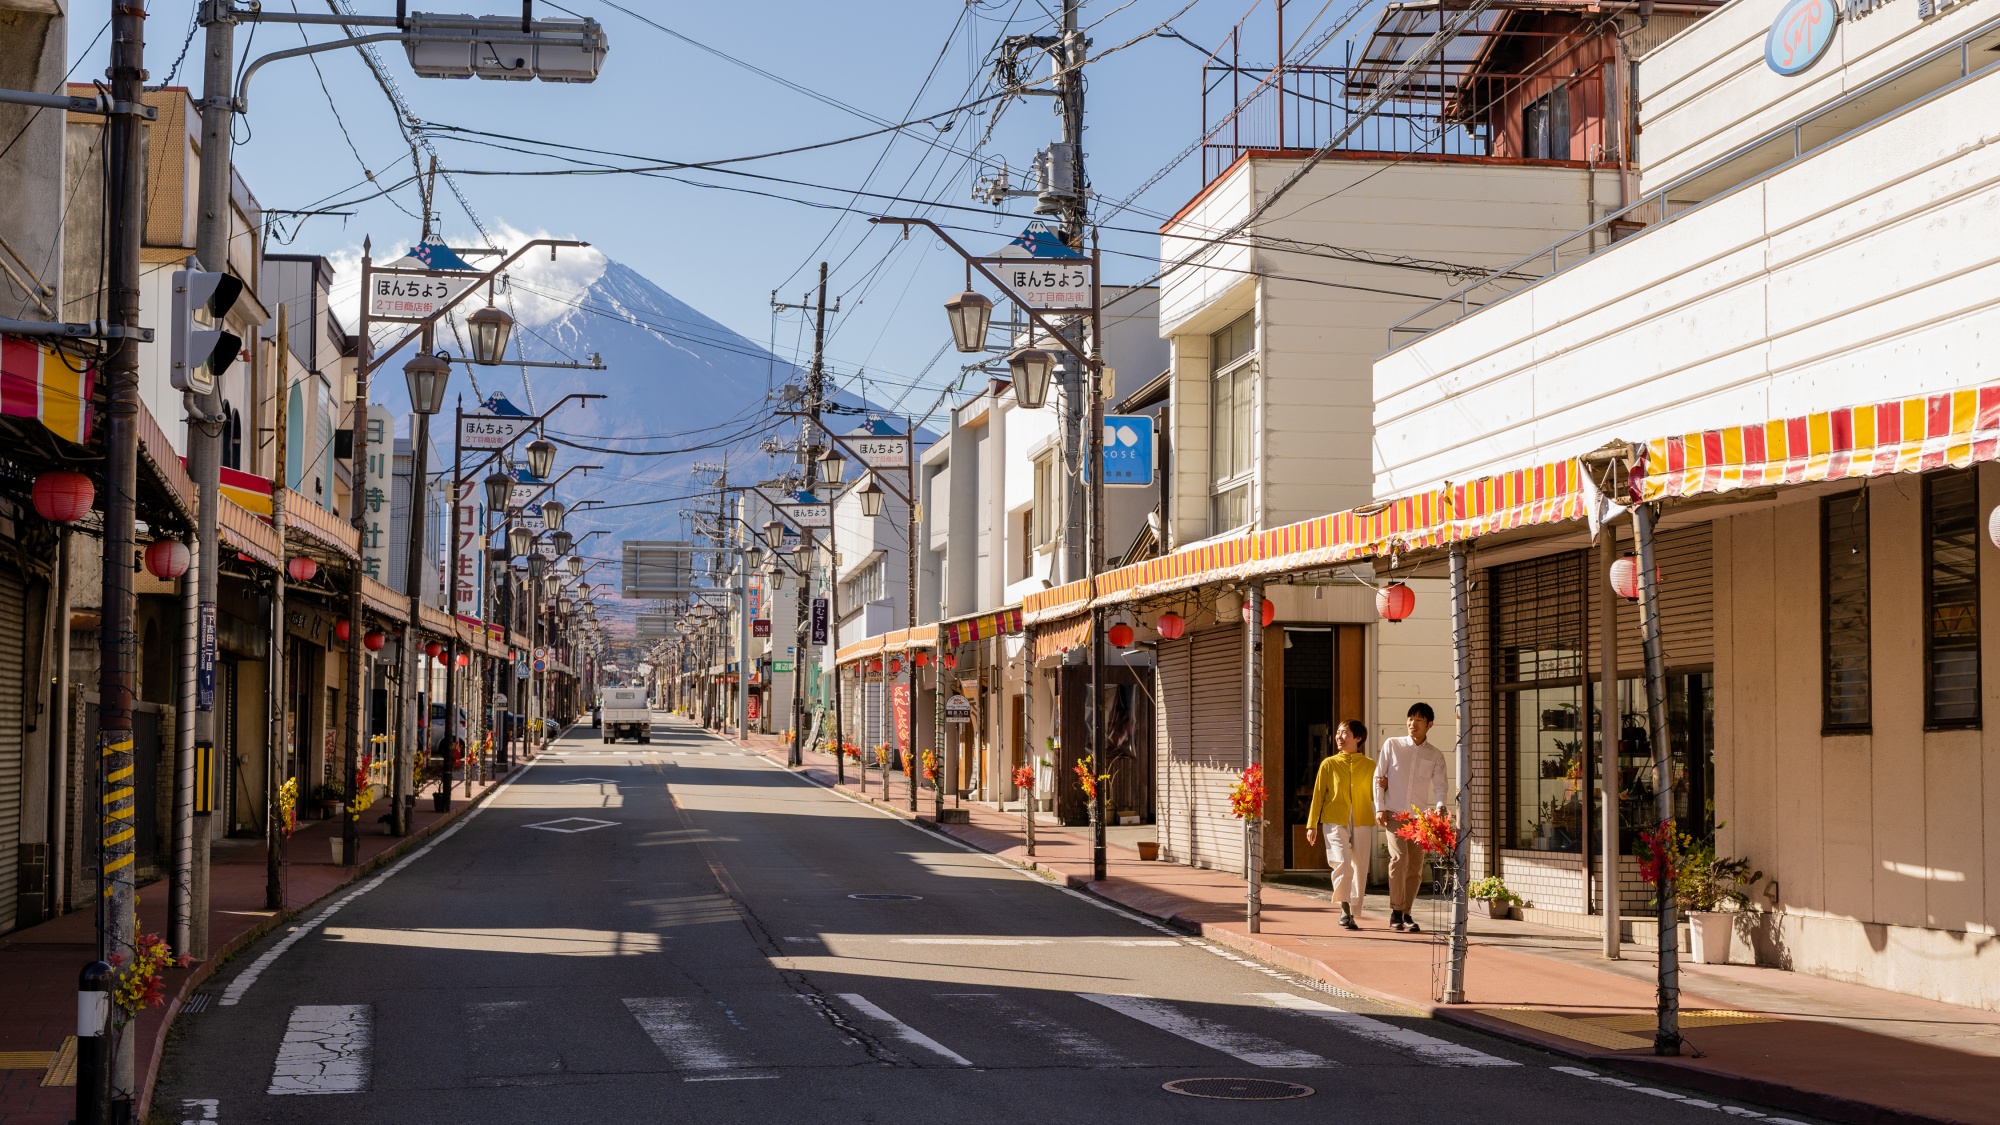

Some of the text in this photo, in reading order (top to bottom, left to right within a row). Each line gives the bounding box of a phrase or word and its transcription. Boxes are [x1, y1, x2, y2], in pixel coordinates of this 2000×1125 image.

[1013, 271, 1085, 288] ほんちょう
[377, 279, 448, 298] ほんちょう
[1028, 292, 1085, 302] 2丁目商店街
[377, 300, 433, 313] 2丁目商店街
[466, 422, 514, 435] ほんちょう
[860, 443, 904, 454] ほんちょう
[1102, 449, 1136, 459] KOSÉ
[793, 508, 827, 518] ほんちょう
